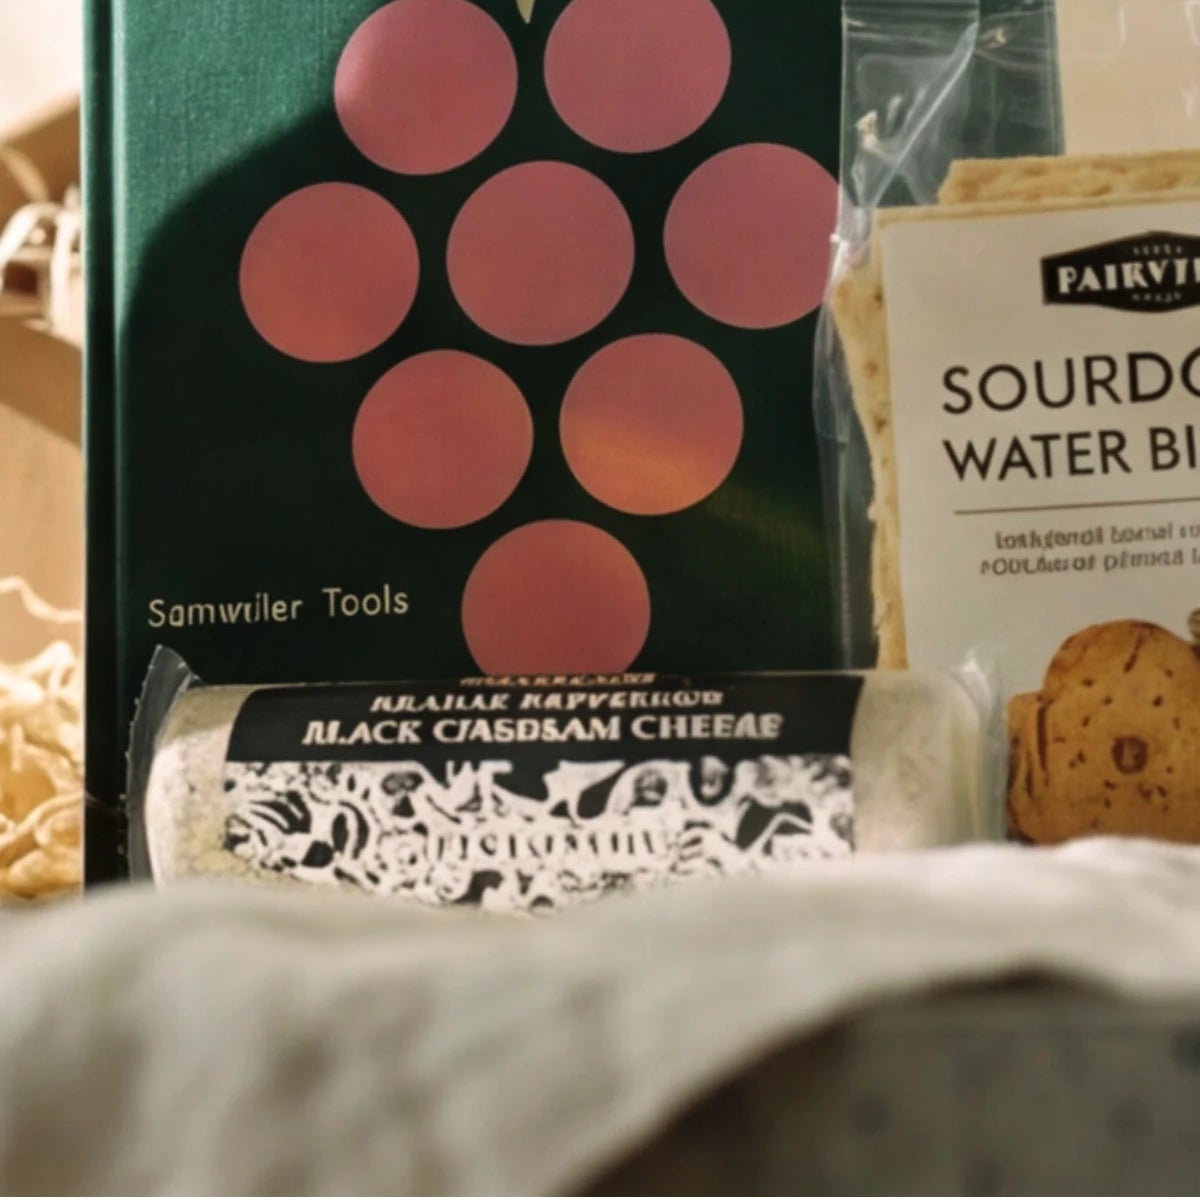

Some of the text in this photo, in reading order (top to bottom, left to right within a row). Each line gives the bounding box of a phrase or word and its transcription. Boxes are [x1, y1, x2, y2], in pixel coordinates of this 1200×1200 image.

[943, 424, 1196, 482] WATER BI
[322, 583, 410, 618] Tools
